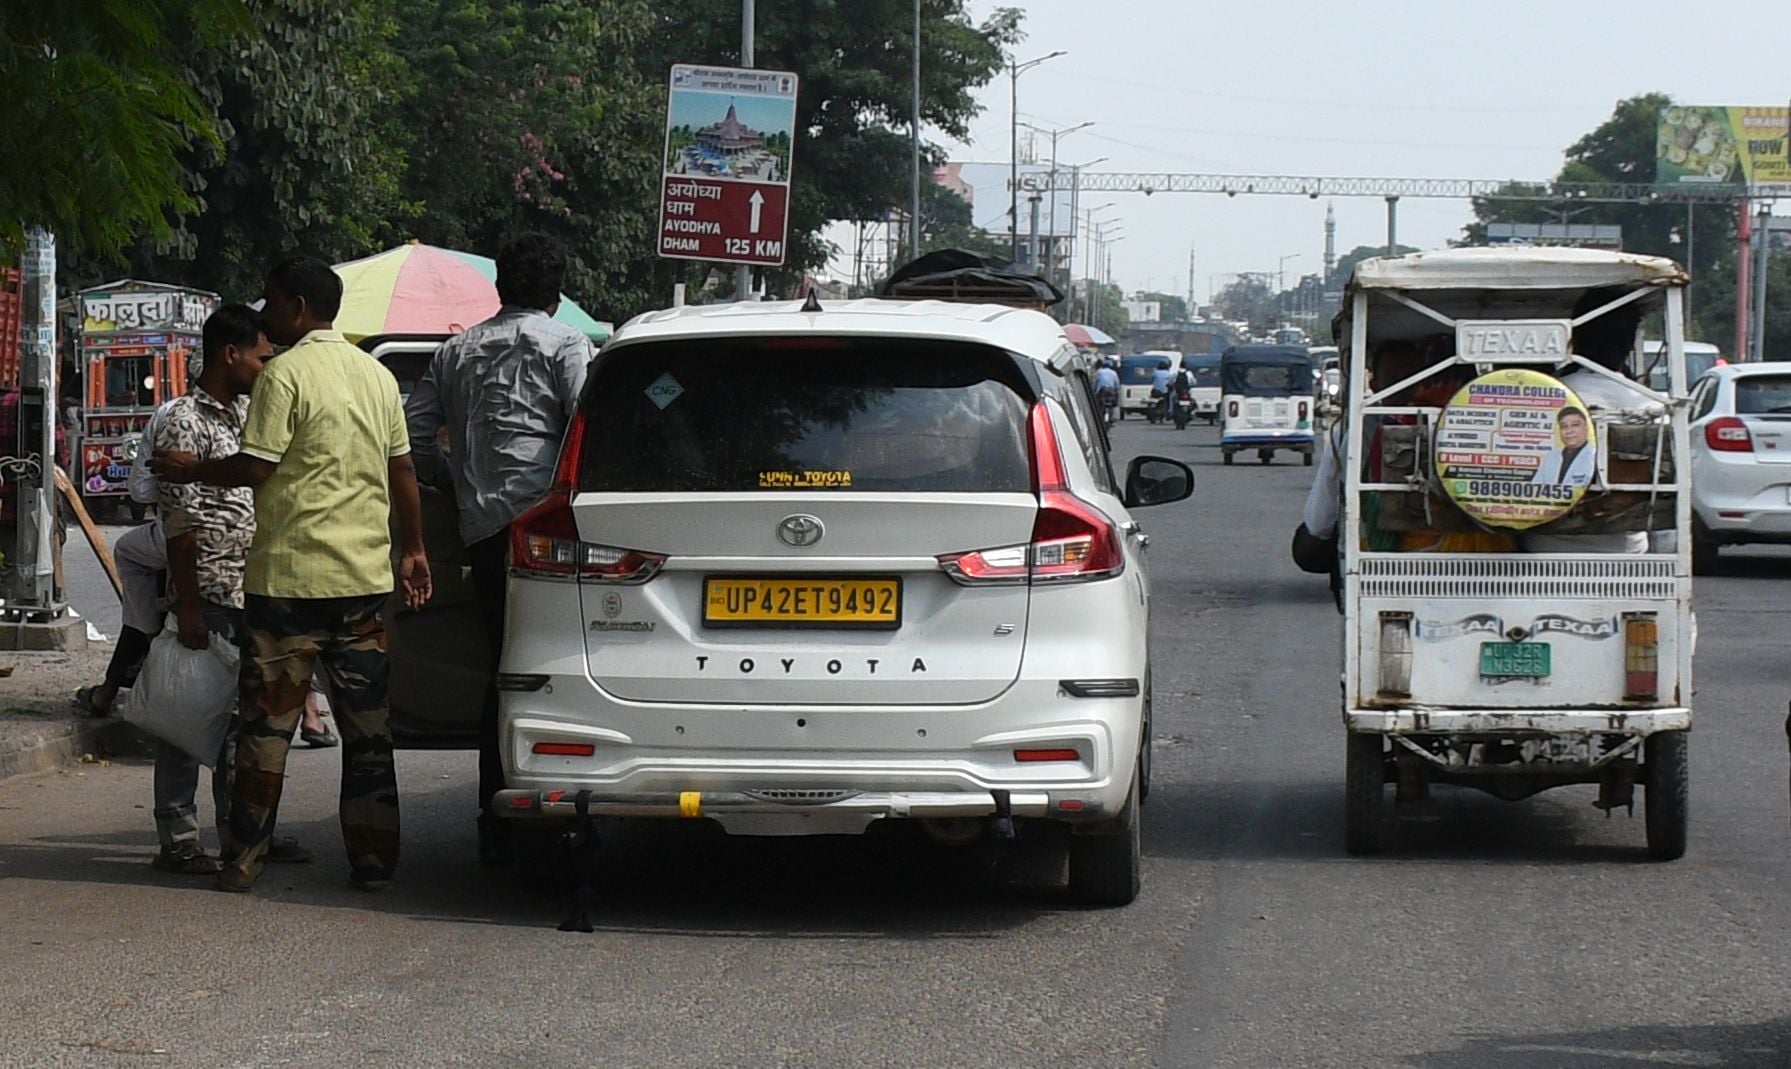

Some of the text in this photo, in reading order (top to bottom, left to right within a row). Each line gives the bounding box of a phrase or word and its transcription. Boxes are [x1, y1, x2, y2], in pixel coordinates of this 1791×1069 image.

[667, 180, 721, 199] अयोध्या
[666, 201, 695, 216] धाम
[665, 219, 721, 235] AYODHYA
[663, 237, 700, 251] DHAM
[725, 238, 781, 257] 125 KM
[1467, 330, 1561, 354] TEXAA
[652, 384, 677, 396] CNG
[1469, 384, 1521, 396] CHANDRA
[803, 471, 852, 482] TOYOTA
[1469, 481, 1574, 500] 9889007455
[727, 587, 893, 615] UP42ET9492
[1534, 618, 1609, 635] TEXAA
[696, 656, 927, 674] TOYOTA
